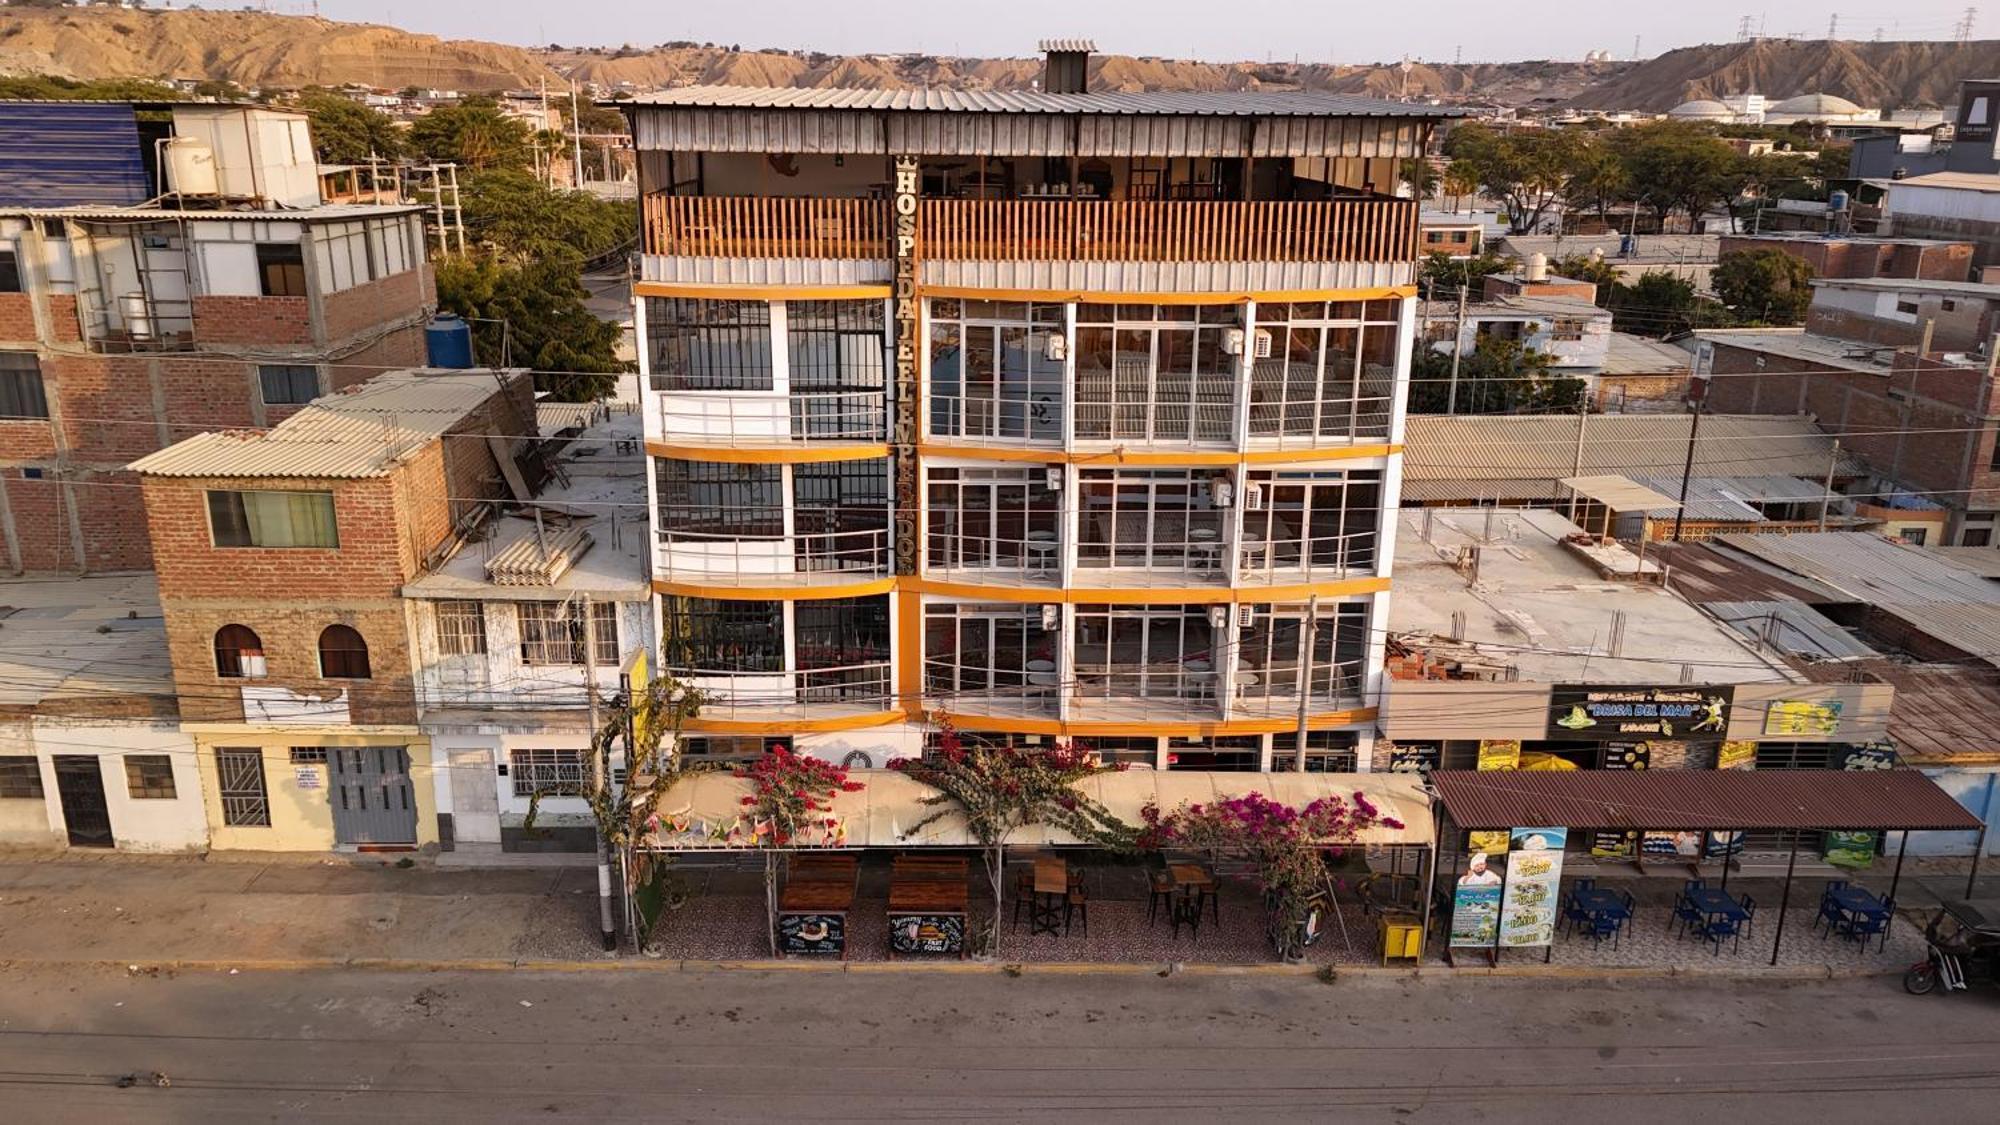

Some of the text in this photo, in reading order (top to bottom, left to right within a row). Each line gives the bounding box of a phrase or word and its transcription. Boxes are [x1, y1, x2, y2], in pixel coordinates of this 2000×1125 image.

[895, 171, 917, 577] HOSPEDAJE EL EMPERADOR
[1634, 704, 1658, 717] DEL
